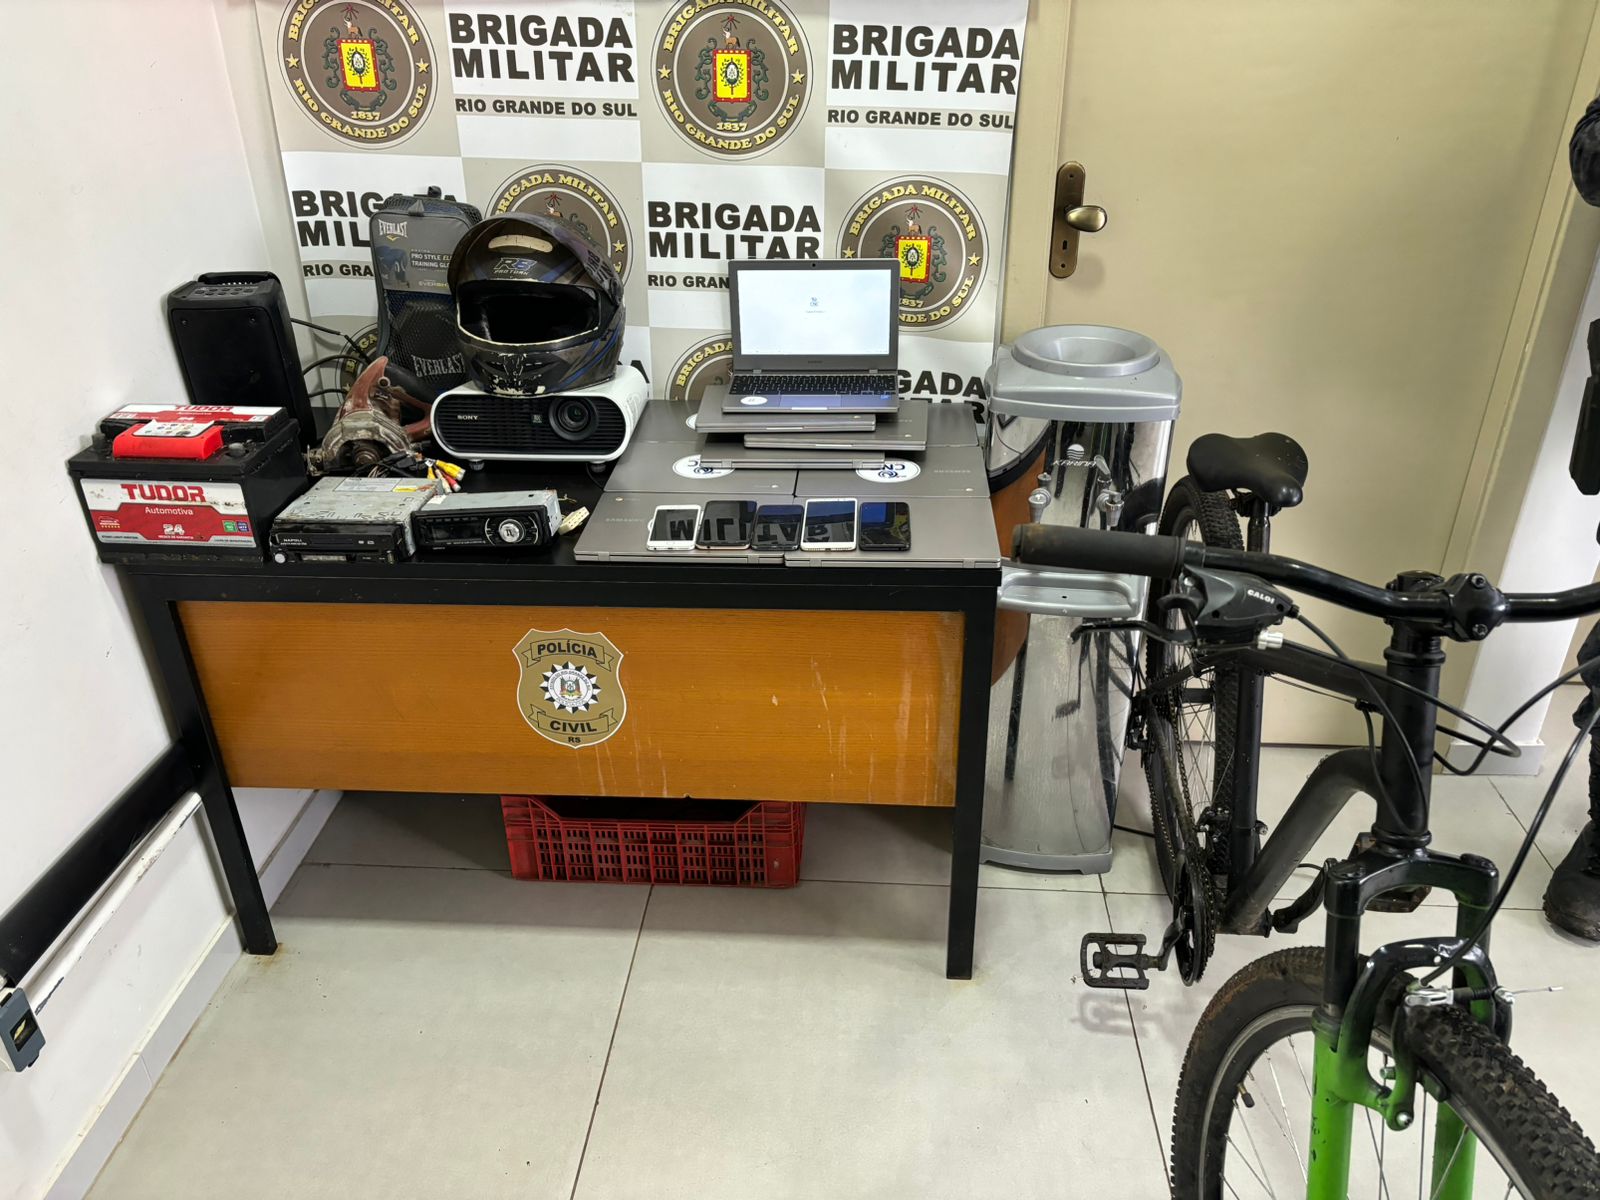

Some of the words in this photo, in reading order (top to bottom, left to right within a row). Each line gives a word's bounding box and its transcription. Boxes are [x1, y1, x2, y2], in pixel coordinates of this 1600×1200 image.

[288, 0, 319, 41] BRIG
[377, 0, 419, 45] ITAR
[450, 14, 632, 48] BRIGADA
[833, 25, 1020, 60] BRIGADA
[453, 49, 634, 82] MILITAR
[832, 60, 1016, 95] MILITAR
[293, 78, 319, 112] RIO
[320, 112, 388, 139] GRANDE
[390, 117, 409, 134] DO
[408, 83, 427, 118] SUL
[351, 111, 381, 121] 1837
[456, 99, 486, 112] RIO
[493, 100, 565, 115] GRANDE
[572, 103, 597, 116] DO
[603, 103, 637, 117] SUL
[663, 89, 685, 124] RIO
[685, 123, 752, 150] GRANDE
[754, 126, 777, 145] DO
[777, 94, 800, 129] SUL
[828, 110, 858, 123] RIO
[866, 111, 941, 126] GRANDE
[948, 113, 973, 127] DO
[979, 114, 1013, 129] SUL
[716, 122, 748, 132] 1837
[292, 190, 385, 218] BRIG
[558, 173, 618, 227] MILITAR
[849, 184, 917, 236] BRIGADA
[921, 184, 977, 241] MILITAR
[378, 219, 408, 238] EVERLAST
[648, 202, 820, 232] BRIGADA
[650, 232, 820, 259] MILITAR
[303, 263, 333, 277] RIO
[339, 264, 374, 277] GRA
[648, 275, 676, 288] RIO
[683, 276, 730, 290] GRAN
[900, 312, 927, 323] NDE
[930, 305, 951, 320] DO
[952, 275, 975, 307] SUL
[898, 370, 987, 400] GADA
[120, 483, 206, 502] TUDOR
[145, 507, 194, 516] Automotiva
[163, 523, 185, 535] 24
[1247, 589, 1275, 604] CALOI
[537, 641, 598, 658] POLÍCIA
[549, 720, 597, 733] CIVIL
